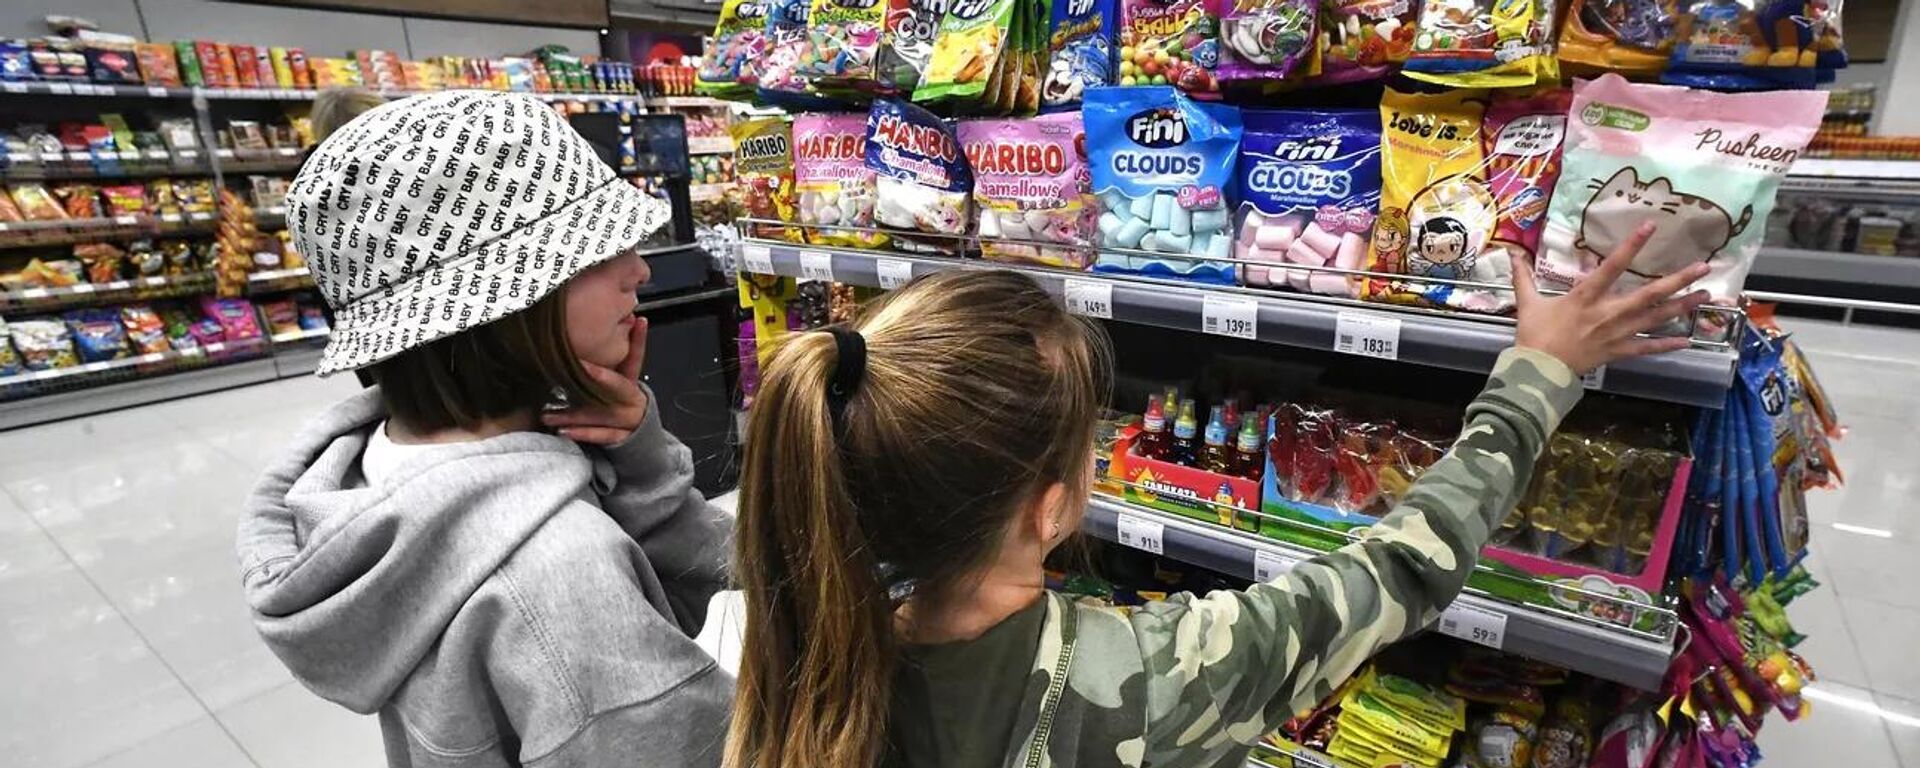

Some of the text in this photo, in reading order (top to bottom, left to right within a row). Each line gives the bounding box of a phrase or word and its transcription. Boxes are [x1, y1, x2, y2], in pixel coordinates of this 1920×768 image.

[433, 120, 450, 138] CRY
[1132, 112, 1184, 143] Fini
[443, 127, 471, 178] CRY BABY
[474, 134, 490, 155] CRY
[515, 122, 534, 168] CRY BABY
[740, 136, 786, 158] HARIBO
[966, 144, 1063, 174] HARIBO
[1275, 138, 1342, 160] Fini
[1694, 128, 1798, 163] Pusheen
[343, 156, 361, 186] BABY
[366, 162, 381, 185] CRY
[408, 146, 438, 198] CRY BABY
[484, 141, 512, 192] CRY BABY
[552, 139, 568, 182] CRY BABY
[1114, 154, 1200, 175] CLOUDS
[451, 162, 480, 216] CRY BABY
[522, 152, 547, 203] CRY BABY
[566, 168, 580, 196] BABY
[980, 180, 1059, 198] hamallows
[336, 187, 352, 210] CRY
[374, 168, 404, 222] CRY BABY
[491, 178, 520, 232] CRY BABY
[540, 190, 557, 218] BABY
[315, 211, 328, 236] CRY
[348, 193, 373, 248] CRY BABY
[417, 184, 448, 237] CRY BABY
[468, 200, 489, 230] BABY
[561, 229, 573, 245] CRY
[568, 204, 584, 228] BABY
[586, 214, 599, 232] CRY
[383, 204, 411, 258] CRY BABY
[433, 221, 454, 252] BABY
[534, 221, 555, 270] CRY BABY
[331, 219, 346, 274] CRY BABY
[361, 233, 378, 288] CRY BABY
[495, 242, 508, 265] CRY
[595, 240, 607, 255] CRY
[348, 256, 357, 288] BABY
[509, 244, 529, 298] CRY BABY
[550, 252, 565, 280] BABY
[567, 256, 580, 276] CRY
[442, 266, 465, 321] CRY BABY
[468, 273, 482, 296] CRY
[487, 274, 501, 303] BABY
[408, 296, 419, 318] CRY
[420, 297, 436, 324] BABY
[1085, 300, 1100, 312] 149
[1226, 319, 1244, 333] 139
[1363, 338, 1384, 352] 183
[1141, 537, 1152, 548] 91
[1472, 627, 1488, 640] 59
